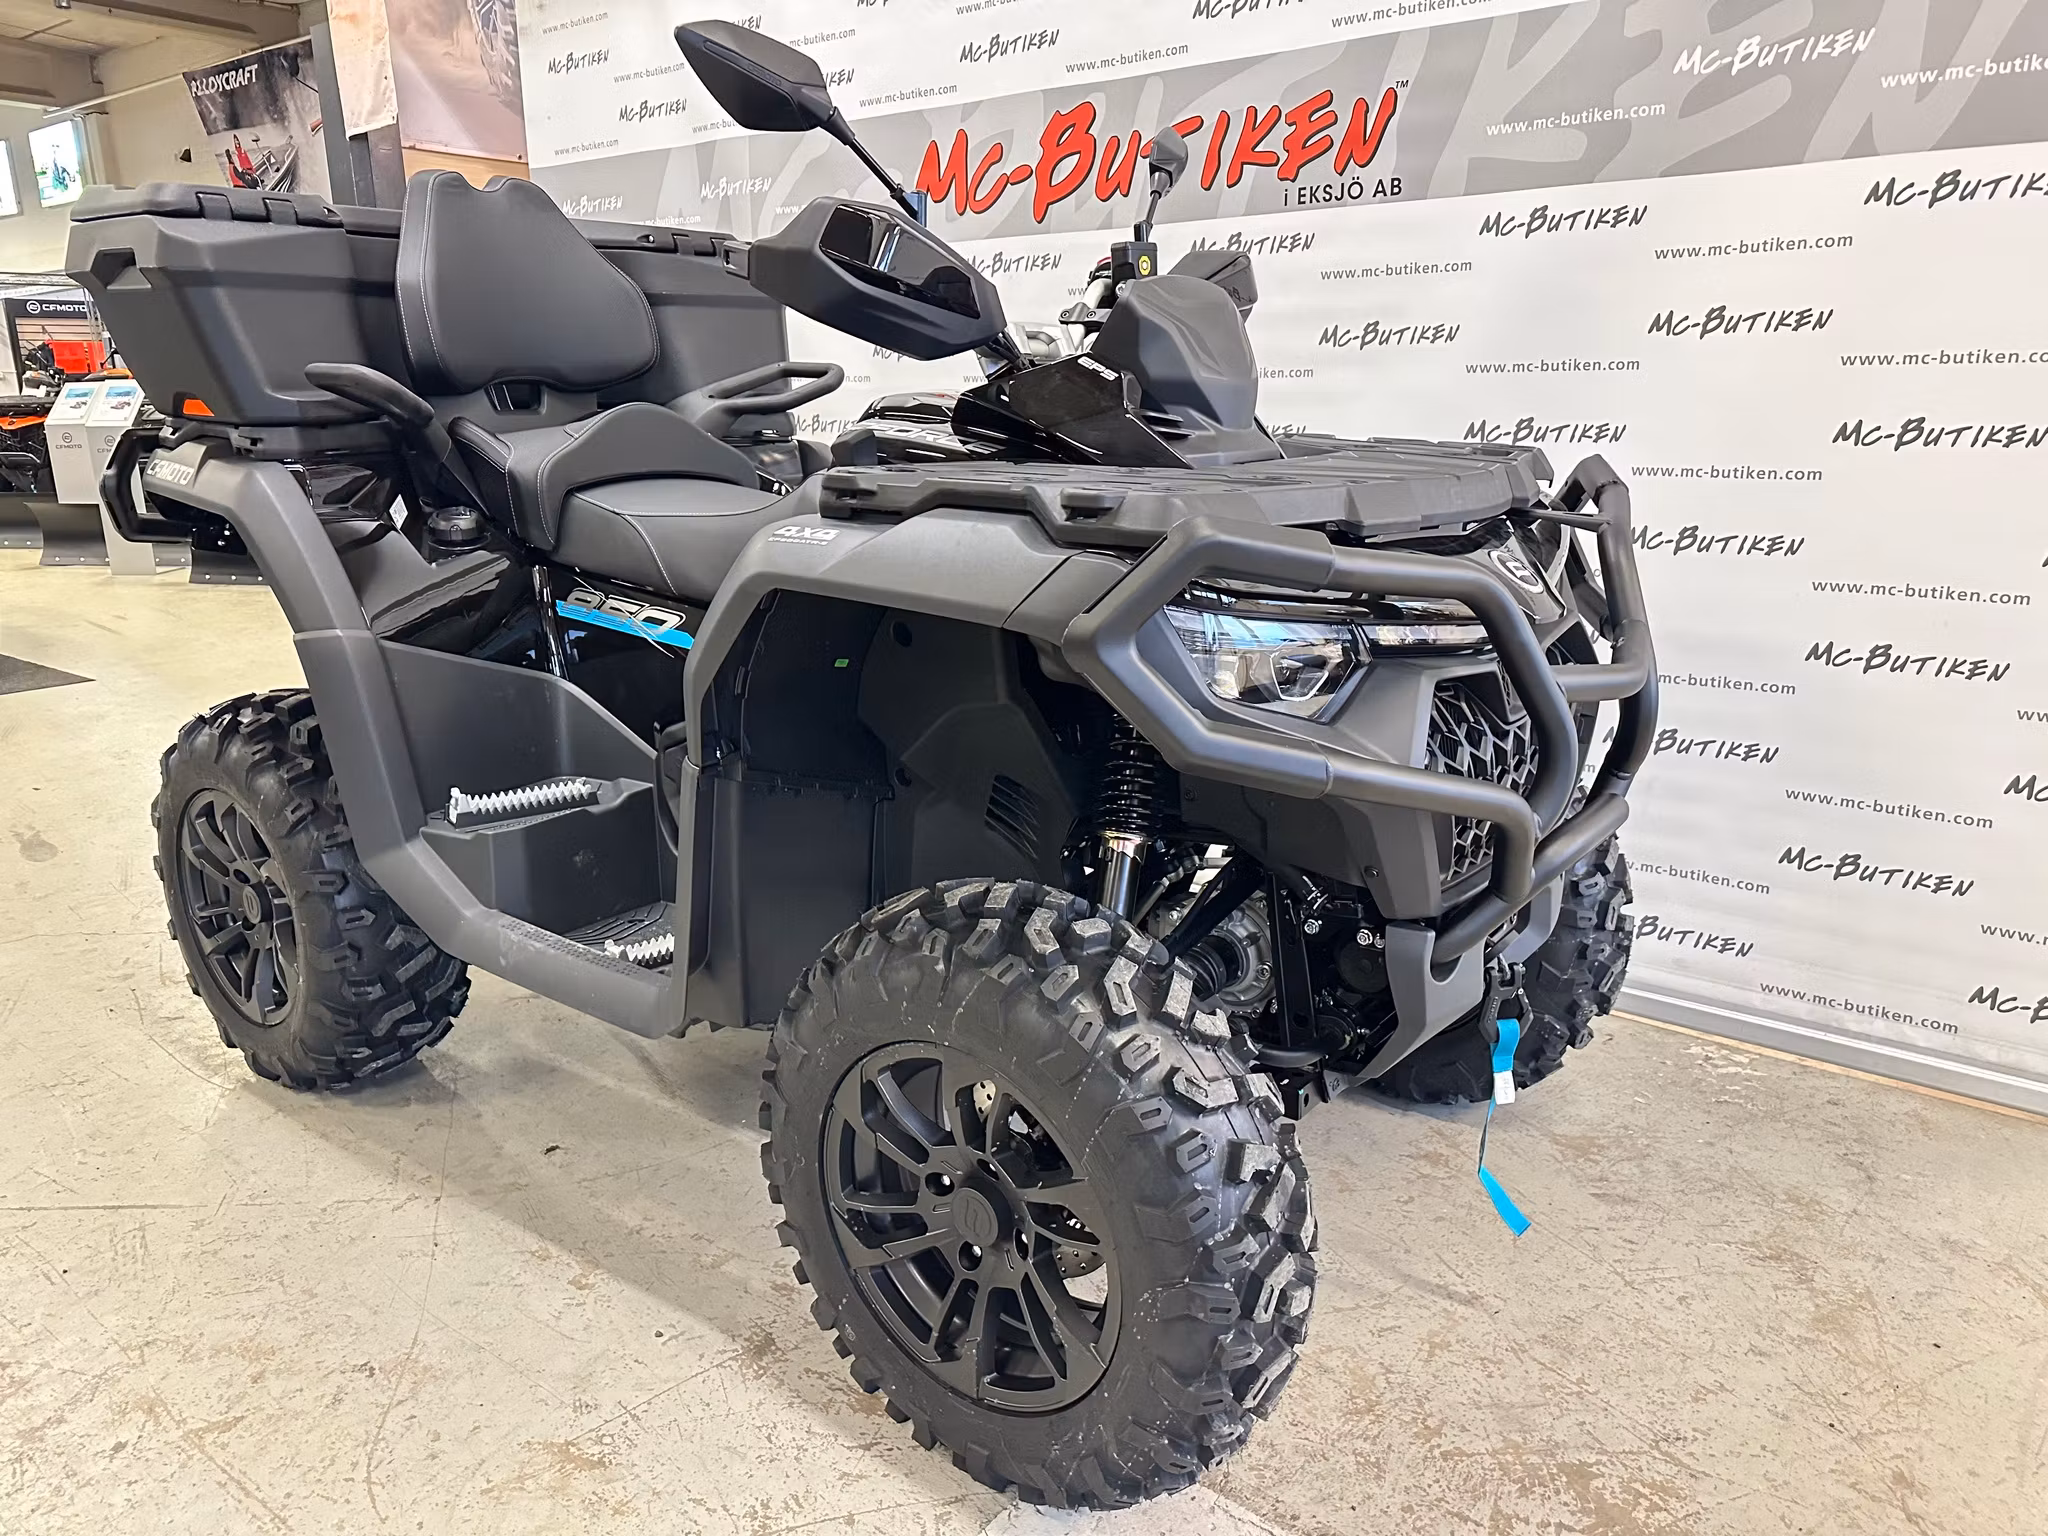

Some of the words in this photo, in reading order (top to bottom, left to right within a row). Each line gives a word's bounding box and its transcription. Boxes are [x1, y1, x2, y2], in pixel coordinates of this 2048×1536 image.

[542, 12, 608, 34] www.mc-butiken.com
[960, 29, 1059, 63] MC-BUTIKEN
[1065, 43, 1189, 73] www.mc-butiken.com
[1673, 28, 1876, 75] MC-BUTIKEN
[548, 50, 609, 74] MC-BUTIKEN
[614, 63, 684, 83] www.mc-butiken.com
[1881, 54, 2048, 88] www.mc-butik
[859, 84, 958, 107] www.mc-butiken.com
[619, 99, 686, 122] MC-BUTIKEN
[1486, 103, 1665, 135] www.mc-butiken.com
[554, 139, 618, 155] www.mc-butiken.com
[700, 177, 771, 201] MC-BUTIKEN
[1298, 176, 1363, 205] EKSJÖ
[1373, 178, 1402, 197] AB
[1864, 169, 2048, 209] MC-BUTIK
[562, 195, 623, 217] MC-BUTIKEN
[1479, 205, 1647, 239] MC-BUTIKEN
[1655, 236, 1852, 259] www.mc-butiken.com
[1321, 262, 1471, 280] www.mc-butiken.com
[42, 304, 87, 312] CFMOTO
[1319, 321, 1460, 350] MC-BUTIKEN
[1648, 305, 1833, 340] MC-BUTIKEN
[1078, 356, 1119, 381] EPS
[1466, 359, 1639, 373] www.mc-butiken.com
[1832, 417, 2048, 451] MC-BUTIKEN
[146, 459, 194, 486] CFMOTO
[1632, 465, 1822, 480] www.mc-butiken.com
[1812, 582, 2030, 605] www.mc-butiken.com
[1805, 641, 2010, 682] MC-BUTIKEN
[1786, 790, 1992, 828] www.mc-butiken.com
[1778, 847, 1974, 896] MC-BUTIKEN
[1760, 982, 1959, 1034] www.mc-butiken.com
